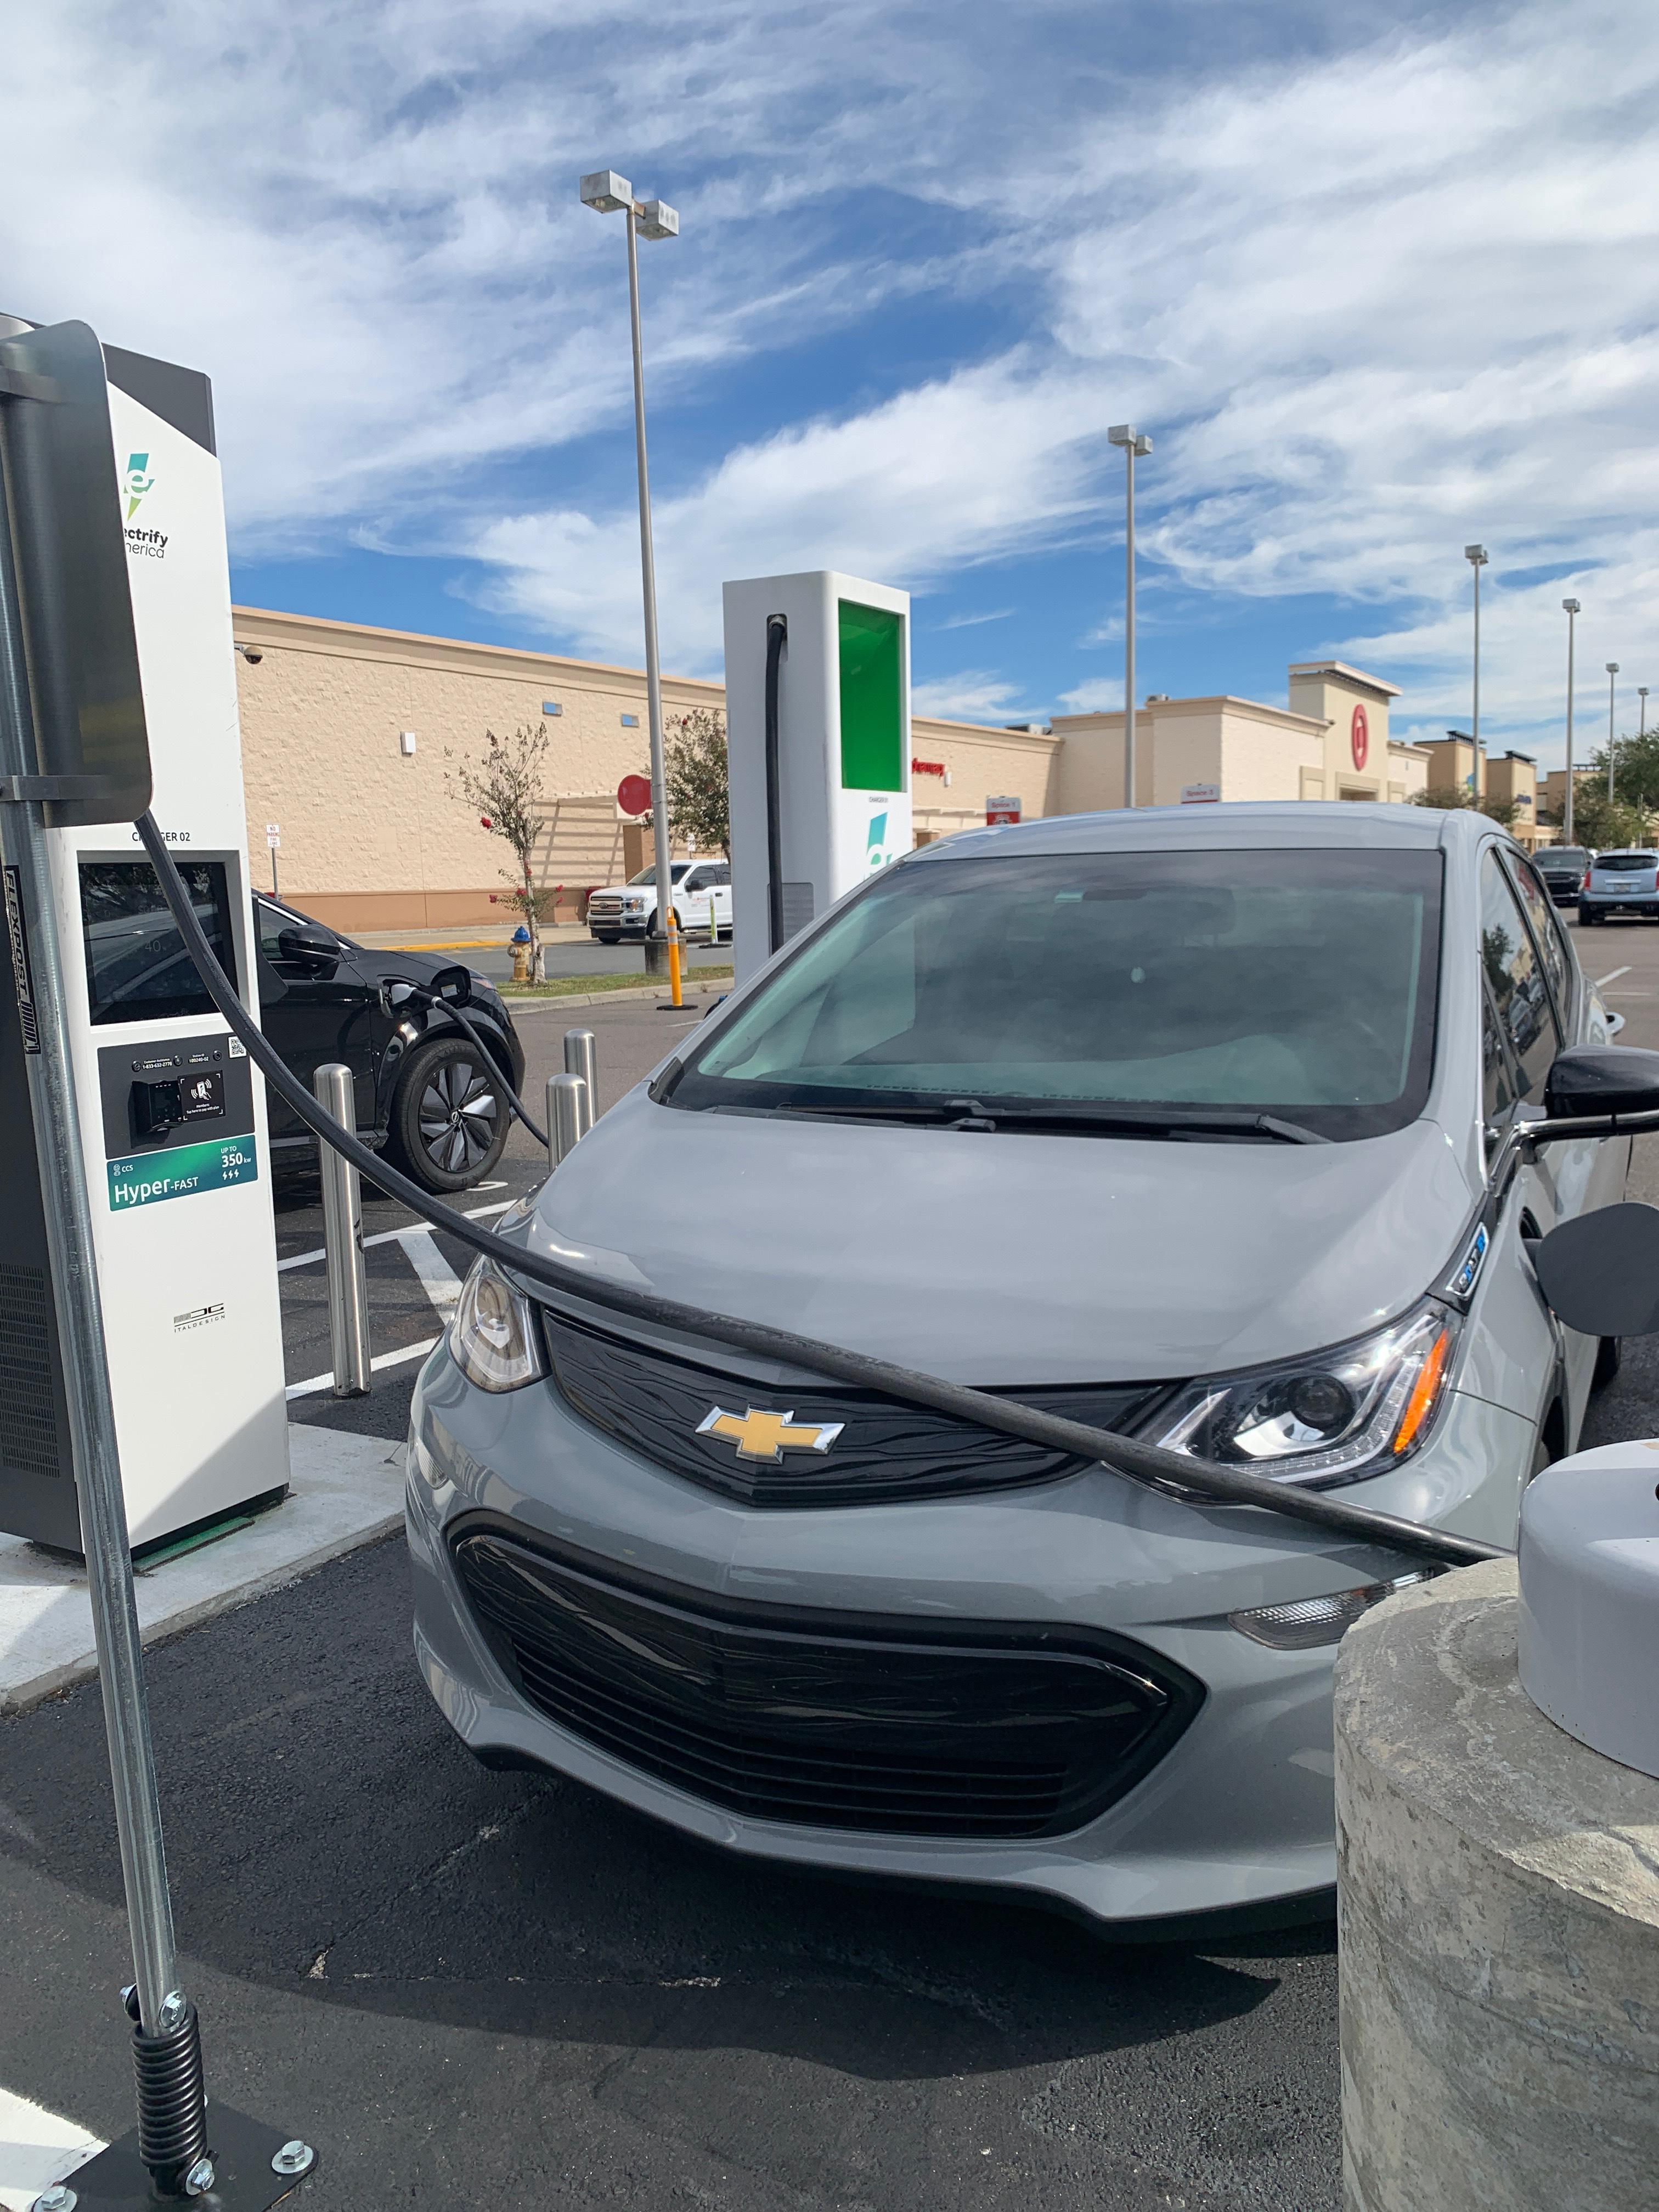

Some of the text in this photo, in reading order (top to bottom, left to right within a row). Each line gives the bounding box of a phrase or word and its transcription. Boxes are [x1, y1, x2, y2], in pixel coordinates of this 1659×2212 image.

[124, 528, 168, 548] ctrify
[179, 832, 190, 842] 02
[7, 871, 27, 996] FLEXPOST
[221, 1152, 243, 1168] 350
[122, 1165, 133, 1173] CCS
[174, 1314, 225, 1333] ITALDESIGN
